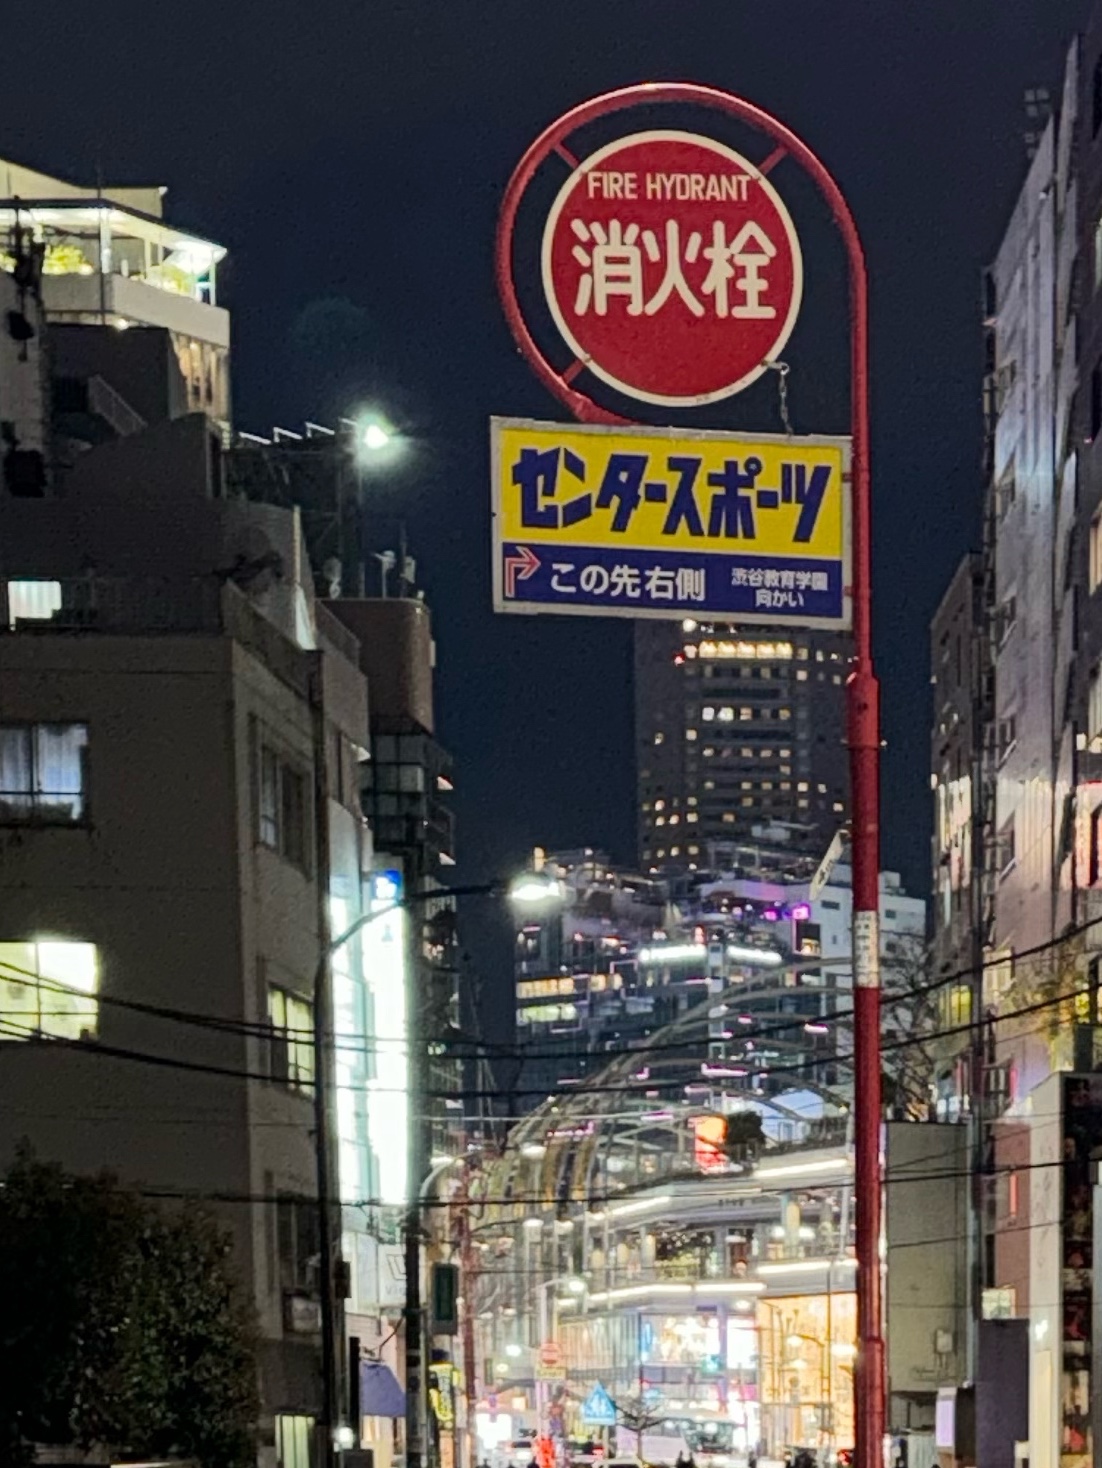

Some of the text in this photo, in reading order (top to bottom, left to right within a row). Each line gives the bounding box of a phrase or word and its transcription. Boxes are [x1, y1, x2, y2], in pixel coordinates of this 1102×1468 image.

[587, 171, 752, 203] FIRE HYDRANT
[570, 218, 778, 320] 消火栓
[511, 446, 832, 544] センタースポーツ
[550, 563, 706, 602] この先右側
[755, 588, 804, 608] 向かい
